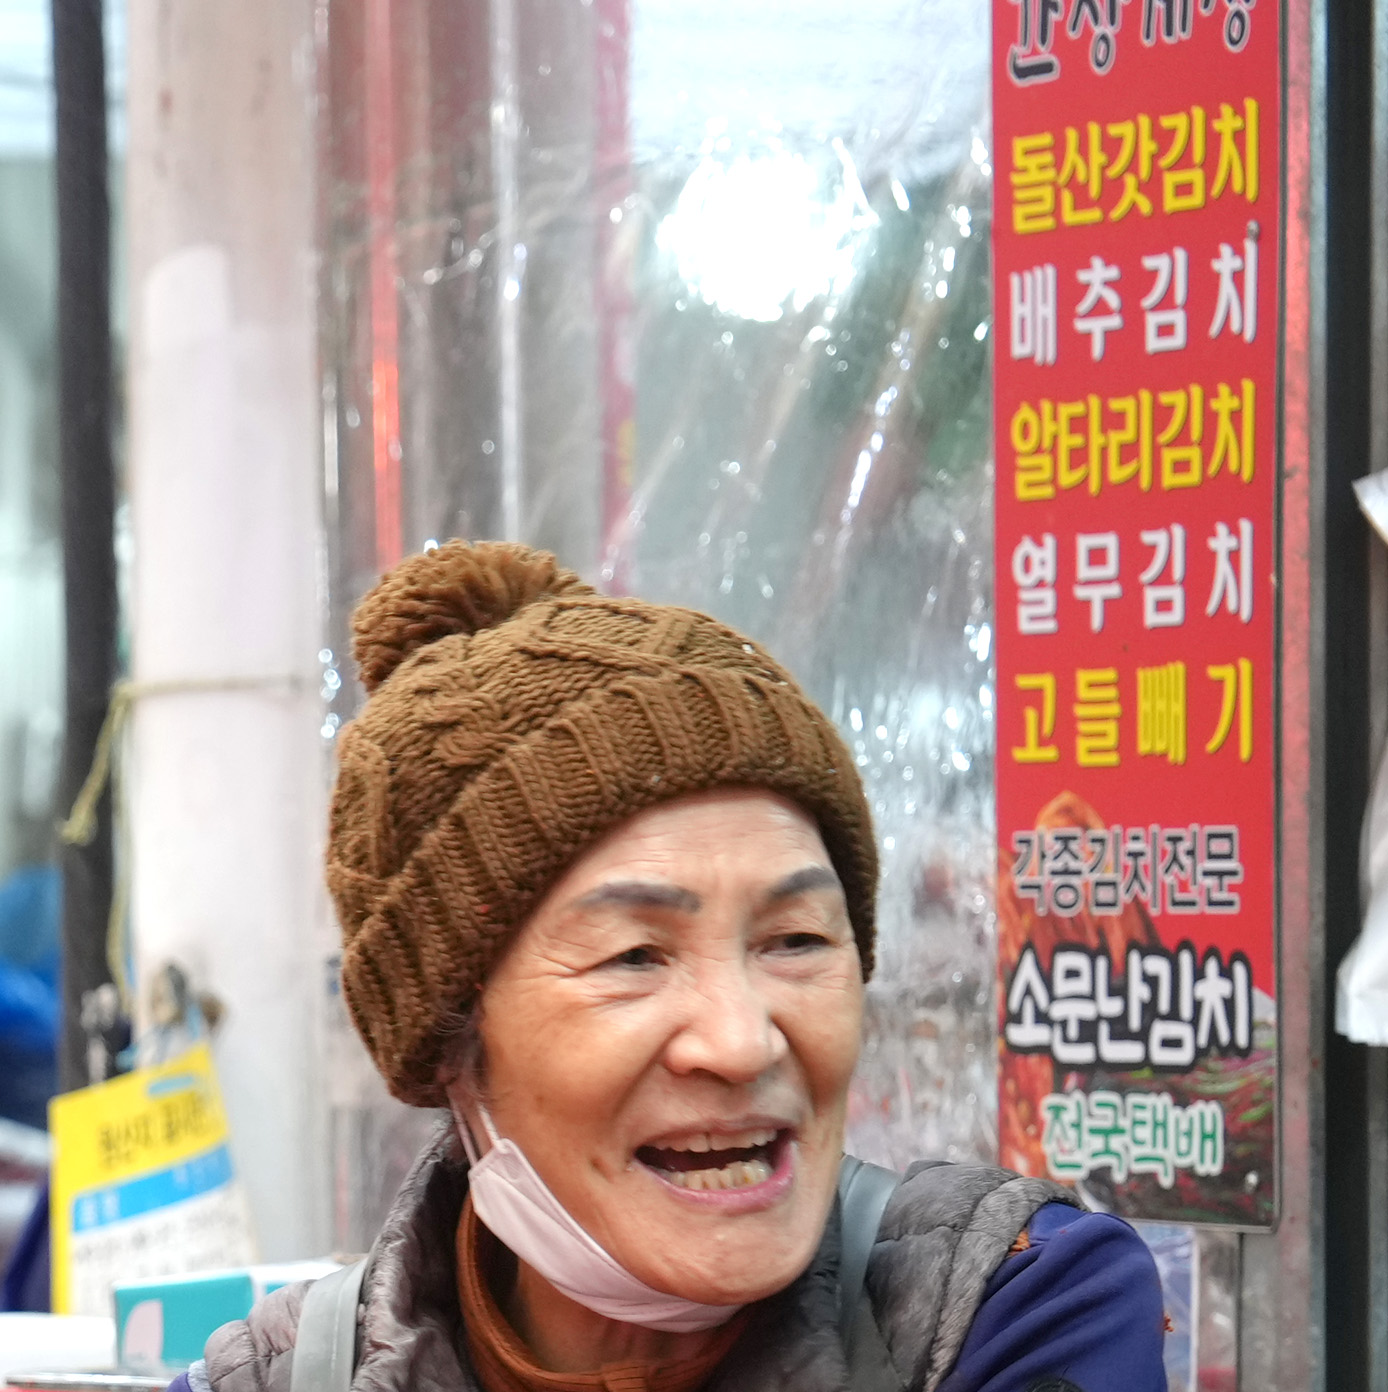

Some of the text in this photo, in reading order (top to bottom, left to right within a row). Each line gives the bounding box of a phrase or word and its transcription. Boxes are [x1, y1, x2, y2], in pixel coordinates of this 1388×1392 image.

[1010, 97, 1260, 234] 돌산갓김치
[1010, 238, 1258, 366] 배추김치
[1011, 379, 1255, 501] 알타리김치
[1011, 518, 1254, 635] 열무김치
[1011, 657, 1254, 767] 고들빼기
[1012, 824, 1243, 915] 각종김치전문
[1005, 945, 1254, 1068] 소문난김치
[1041, 1093, 1224, 1186] 전국택배
